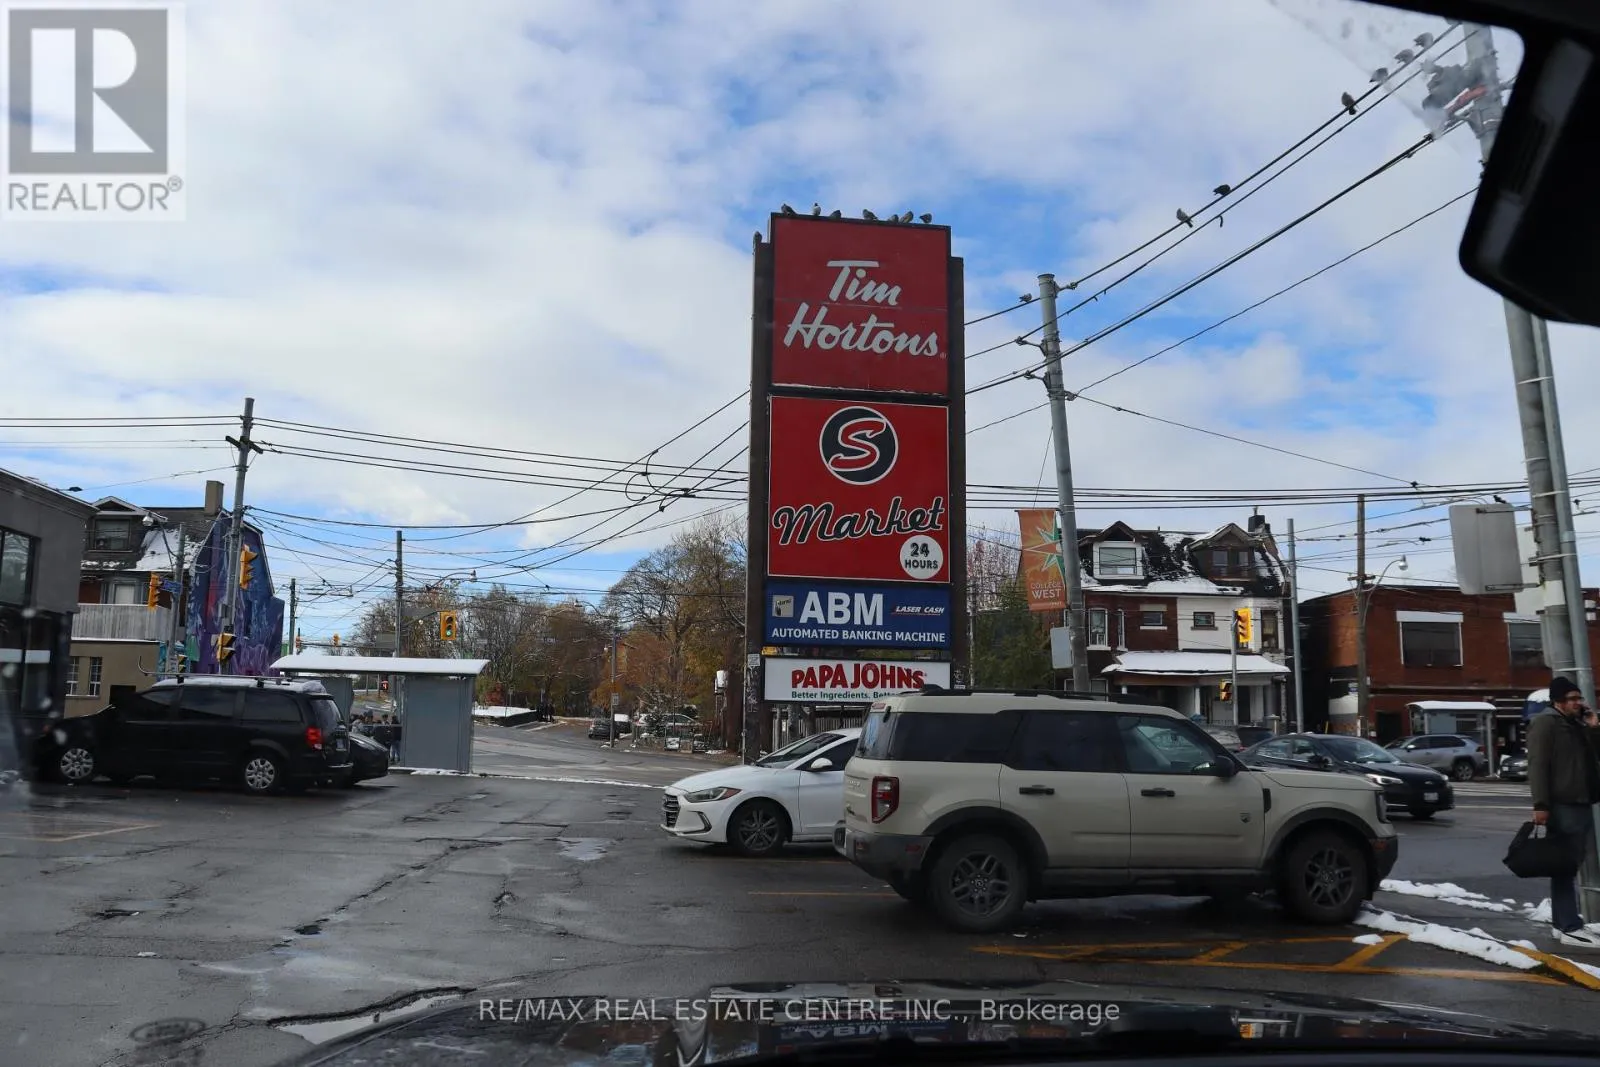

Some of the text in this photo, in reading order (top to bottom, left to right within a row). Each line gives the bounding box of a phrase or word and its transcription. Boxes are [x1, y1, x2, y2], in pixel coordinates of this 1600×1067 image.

[826, 260, 902, 306] Tim
[783, 302, 938, 357] Hortons
[829, 417, 887, 472] S
[772, 496, 944, 546] Market
[910, 542, 930, 557] 24
[904, 559, 939, 569] HOURS
[1031, 588, 1062, 600] WEST
[799, 590, 884, 626] ABM
[895, 605, 945, 614] LASER CASH
[771, 628, 946, 643] AUTOMATED BANKING MACHINE
[791, 664, 848, 689] PAPA
[791, 691, 818, 699] Better
